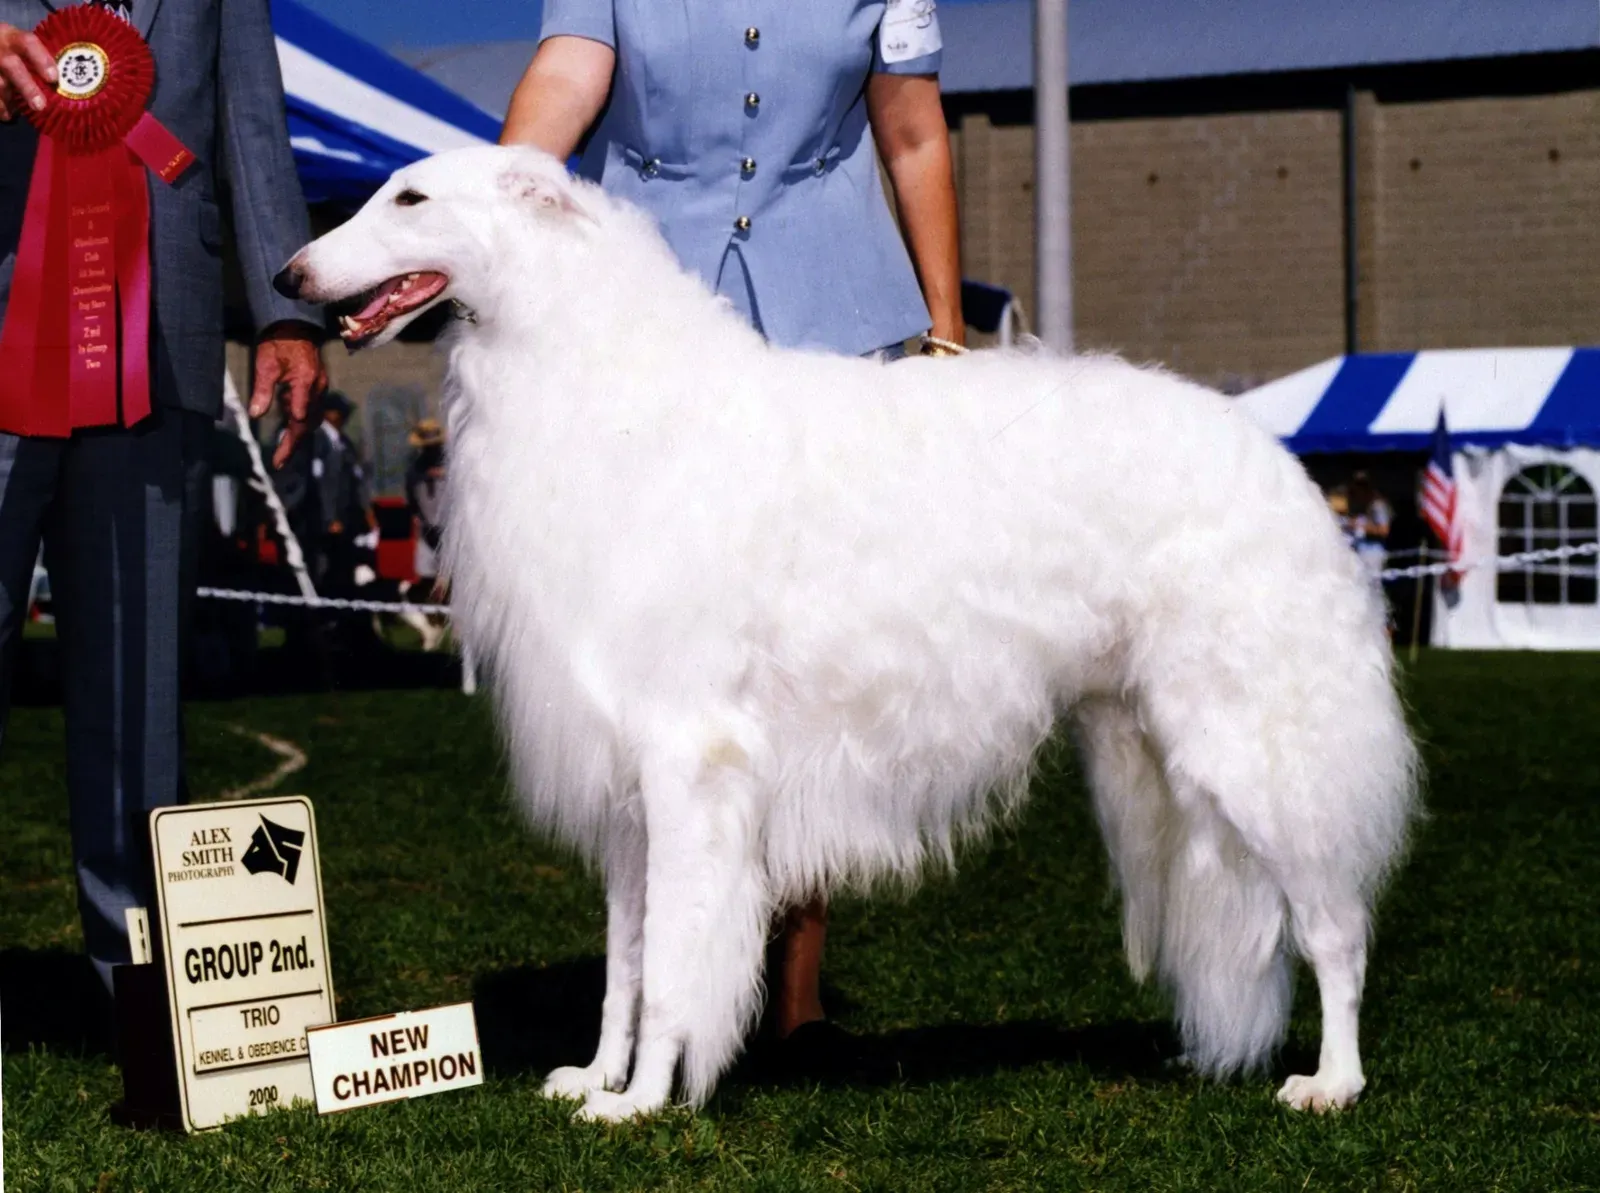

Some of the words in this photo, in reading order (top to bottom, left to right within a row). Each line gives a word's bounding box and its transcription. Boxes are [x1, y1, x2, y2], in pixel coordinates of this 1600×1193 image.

[190, 827, 232, 846] ALEX
[182, 847, 234, 867] SMITH
[168, 866, 235, 883] PHOTOGRAPHY
[185, 941, 263, 984] GROUP
[269, 935, 315, 973] 2nd.
[240, 1005, 281, 1029] TRIO
[199, 1047, 234, 1065] KENNEL
[238, 1046, 244, 1060] &
[248, 1038, 297, 1058] OBEDIENCE
[370, 1024, 429, 1059] NEW
[332, 1051, 476, 1101] CHAMPION
[249, 1085, 278, 1106] 2000
